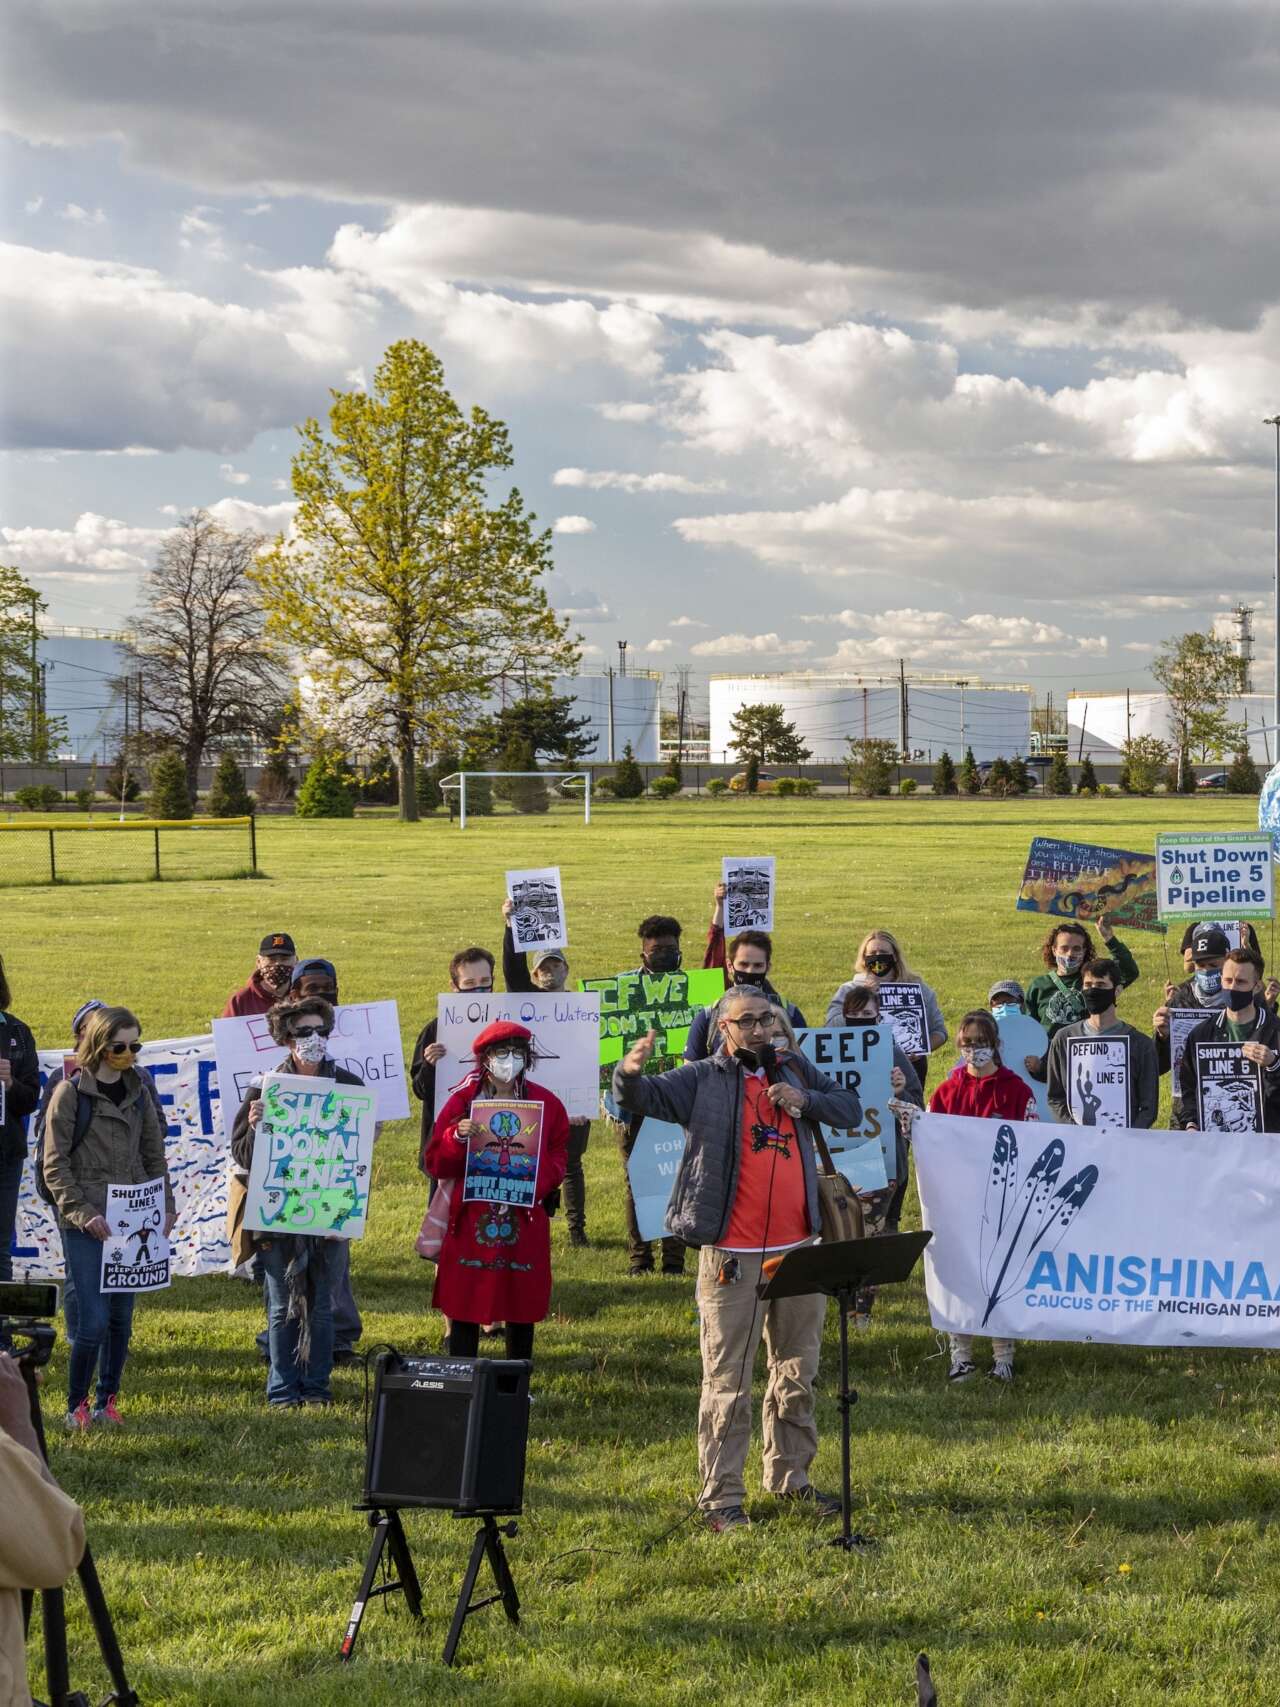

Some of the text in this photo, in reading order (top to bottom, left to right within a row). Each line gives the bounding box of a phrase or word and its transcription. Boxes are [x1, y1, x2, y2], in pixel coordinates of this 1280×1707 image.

[1034, 850, 1048, 858] you
[1053, 852, 1072, 861] who
[1036, 840, 1060, 850] When
[1068, 843, 1090, 856] they
[1161, 848, 1268, 864] Shut Down
[1054, 860, 1112, 876] BELIEVE
[1190, 865, 1263, 884] Line 5
[1168, 886, 1266, 908] Pipeline
[1197, 939, 1208, 952] E
[586, 973, 688, 1013] IF WE
[882, 994, 916, 1006] LINE 5
[445, 1006, 464, 1025] No
[467, 1002, 488, 1022] Oil
[520, 1002, 548, 1022] Our
[554, 1002, 599, 1022] Waters
[246, 1007, 377, 1051] ECT
[1073, 1043, 1109, 1056] DEFUND
[1199, 1048, 1226, 1058] SHUT
[1209, 1060, 1234, 1074] LINE
[1096, 1072, 1124, 1084] LINE 5
[274, 1092, 370, 1131] SHUT
[270, 1132, 359, 1162] DOWN
[654, 1140, 682, 1154] FOR
[264, 1162, 354, 1189] LINE
[112, 1183, 163, 1198] SHUT DOWN
[467, 1176, 535, 1192] SHUT DOWN
[129, 1198, 150, 1209] LINE
[474, 1188, 523, 1203] LINE 5!
[292, 1192, 320, 1225] 5
[108, 1265, 130, 1273] KEEP
[154, 1261, 166, 1270] THE
[107, 1270, 166, 1286] GROUND
[1026, 1294, 1093, 1311] CAUCUS
[1098, 1298, 1120, 1311] OF
[1125, 1300, 1153, 1312] THE
[1158, 1300, 1240, 1316] MICHIGAN
[411, 1379, 444, 1390] ALESIS
